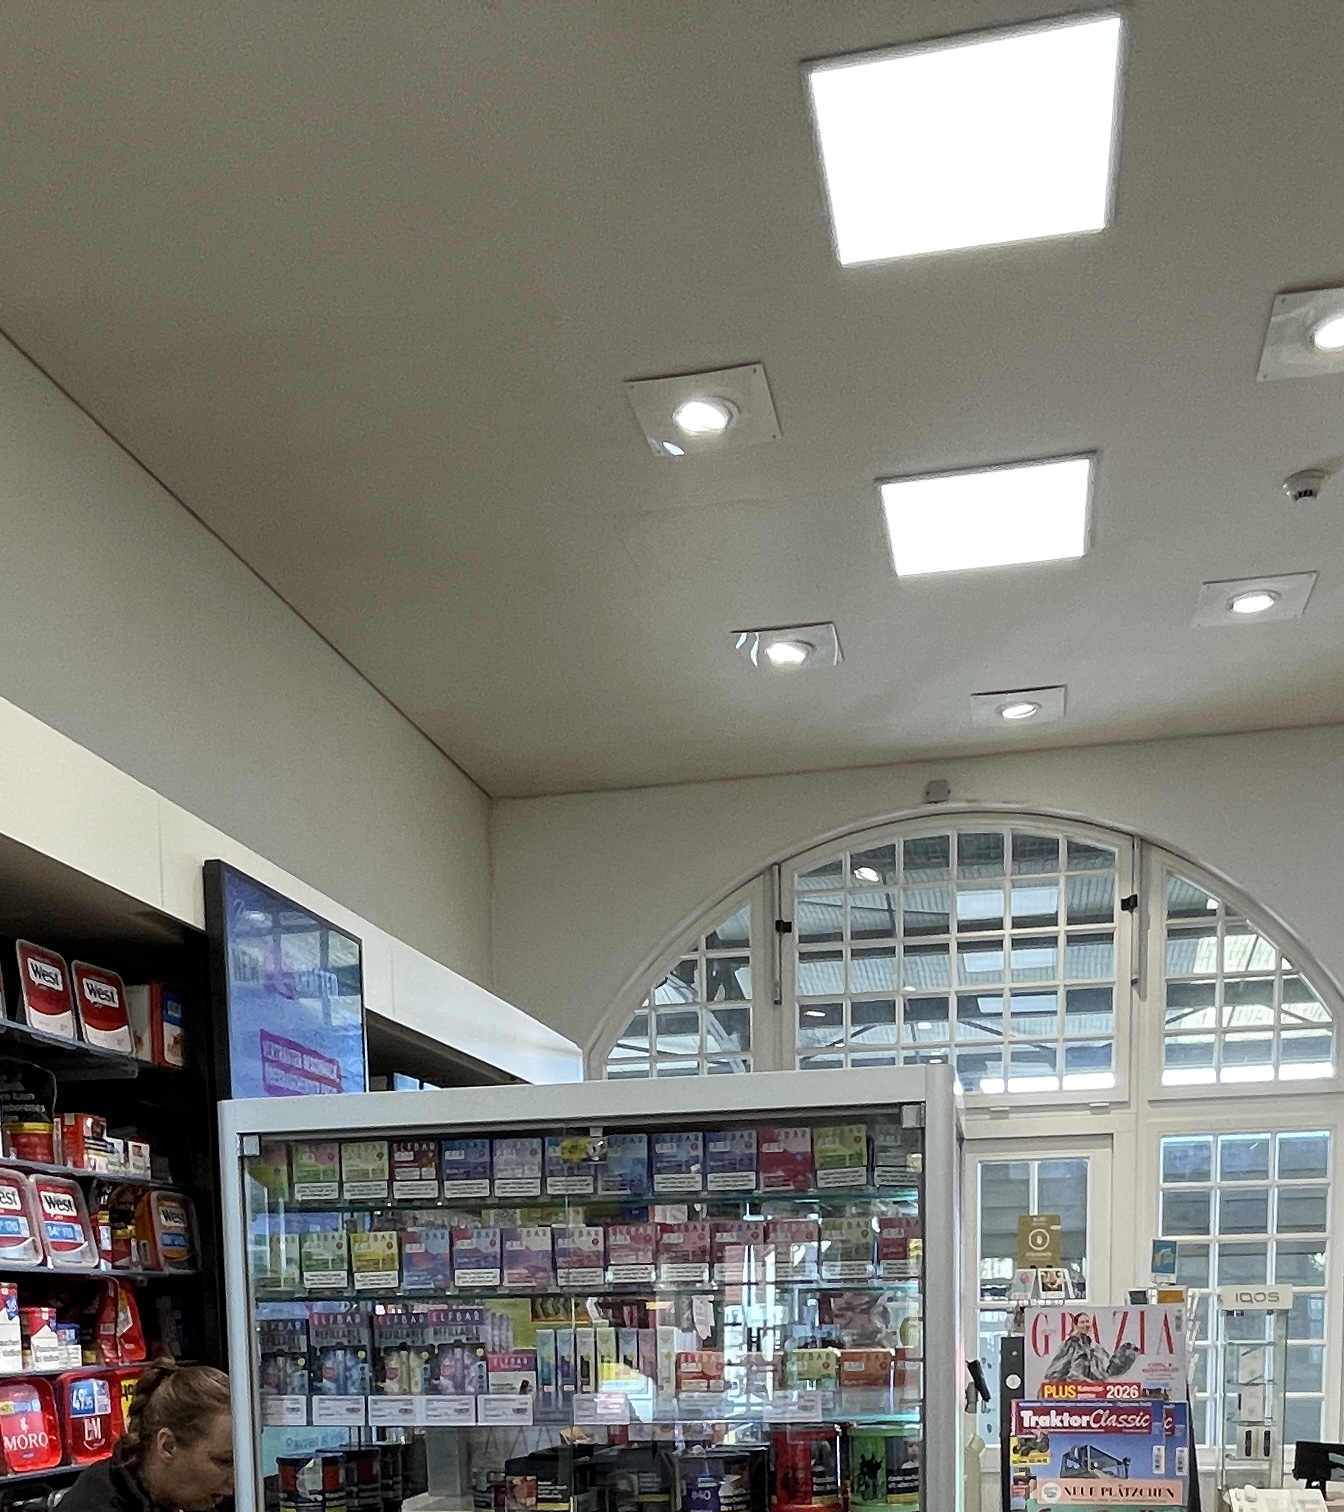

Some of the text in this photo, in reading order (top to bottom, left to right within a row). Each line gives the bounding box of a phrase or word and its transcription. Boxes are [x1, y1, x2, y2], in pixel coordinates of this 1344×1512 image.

[31, 962, 61, 987] West
[86, 982, 118, 1006] West
[43, 1195, 75, 1213] West
[161, 1208, 186, 1224] West
[1235, 1292, 1280, 1304] IQOS
[313, 1312, 361, 1324] ELFBAR
[377, 1313, 426, 1324] ELFBAR
[431, 1310, 481, 1322] ELFBAR
[433, 1326, 481, 1339] REFILLABLE
[1031, 1310, 1175, 1358] GRAZIA
[1044, 1385, 1139, 1399] PLUS 2026
[1064, 1483, 1175, 1499] NEUE PLÄTZCHEN
